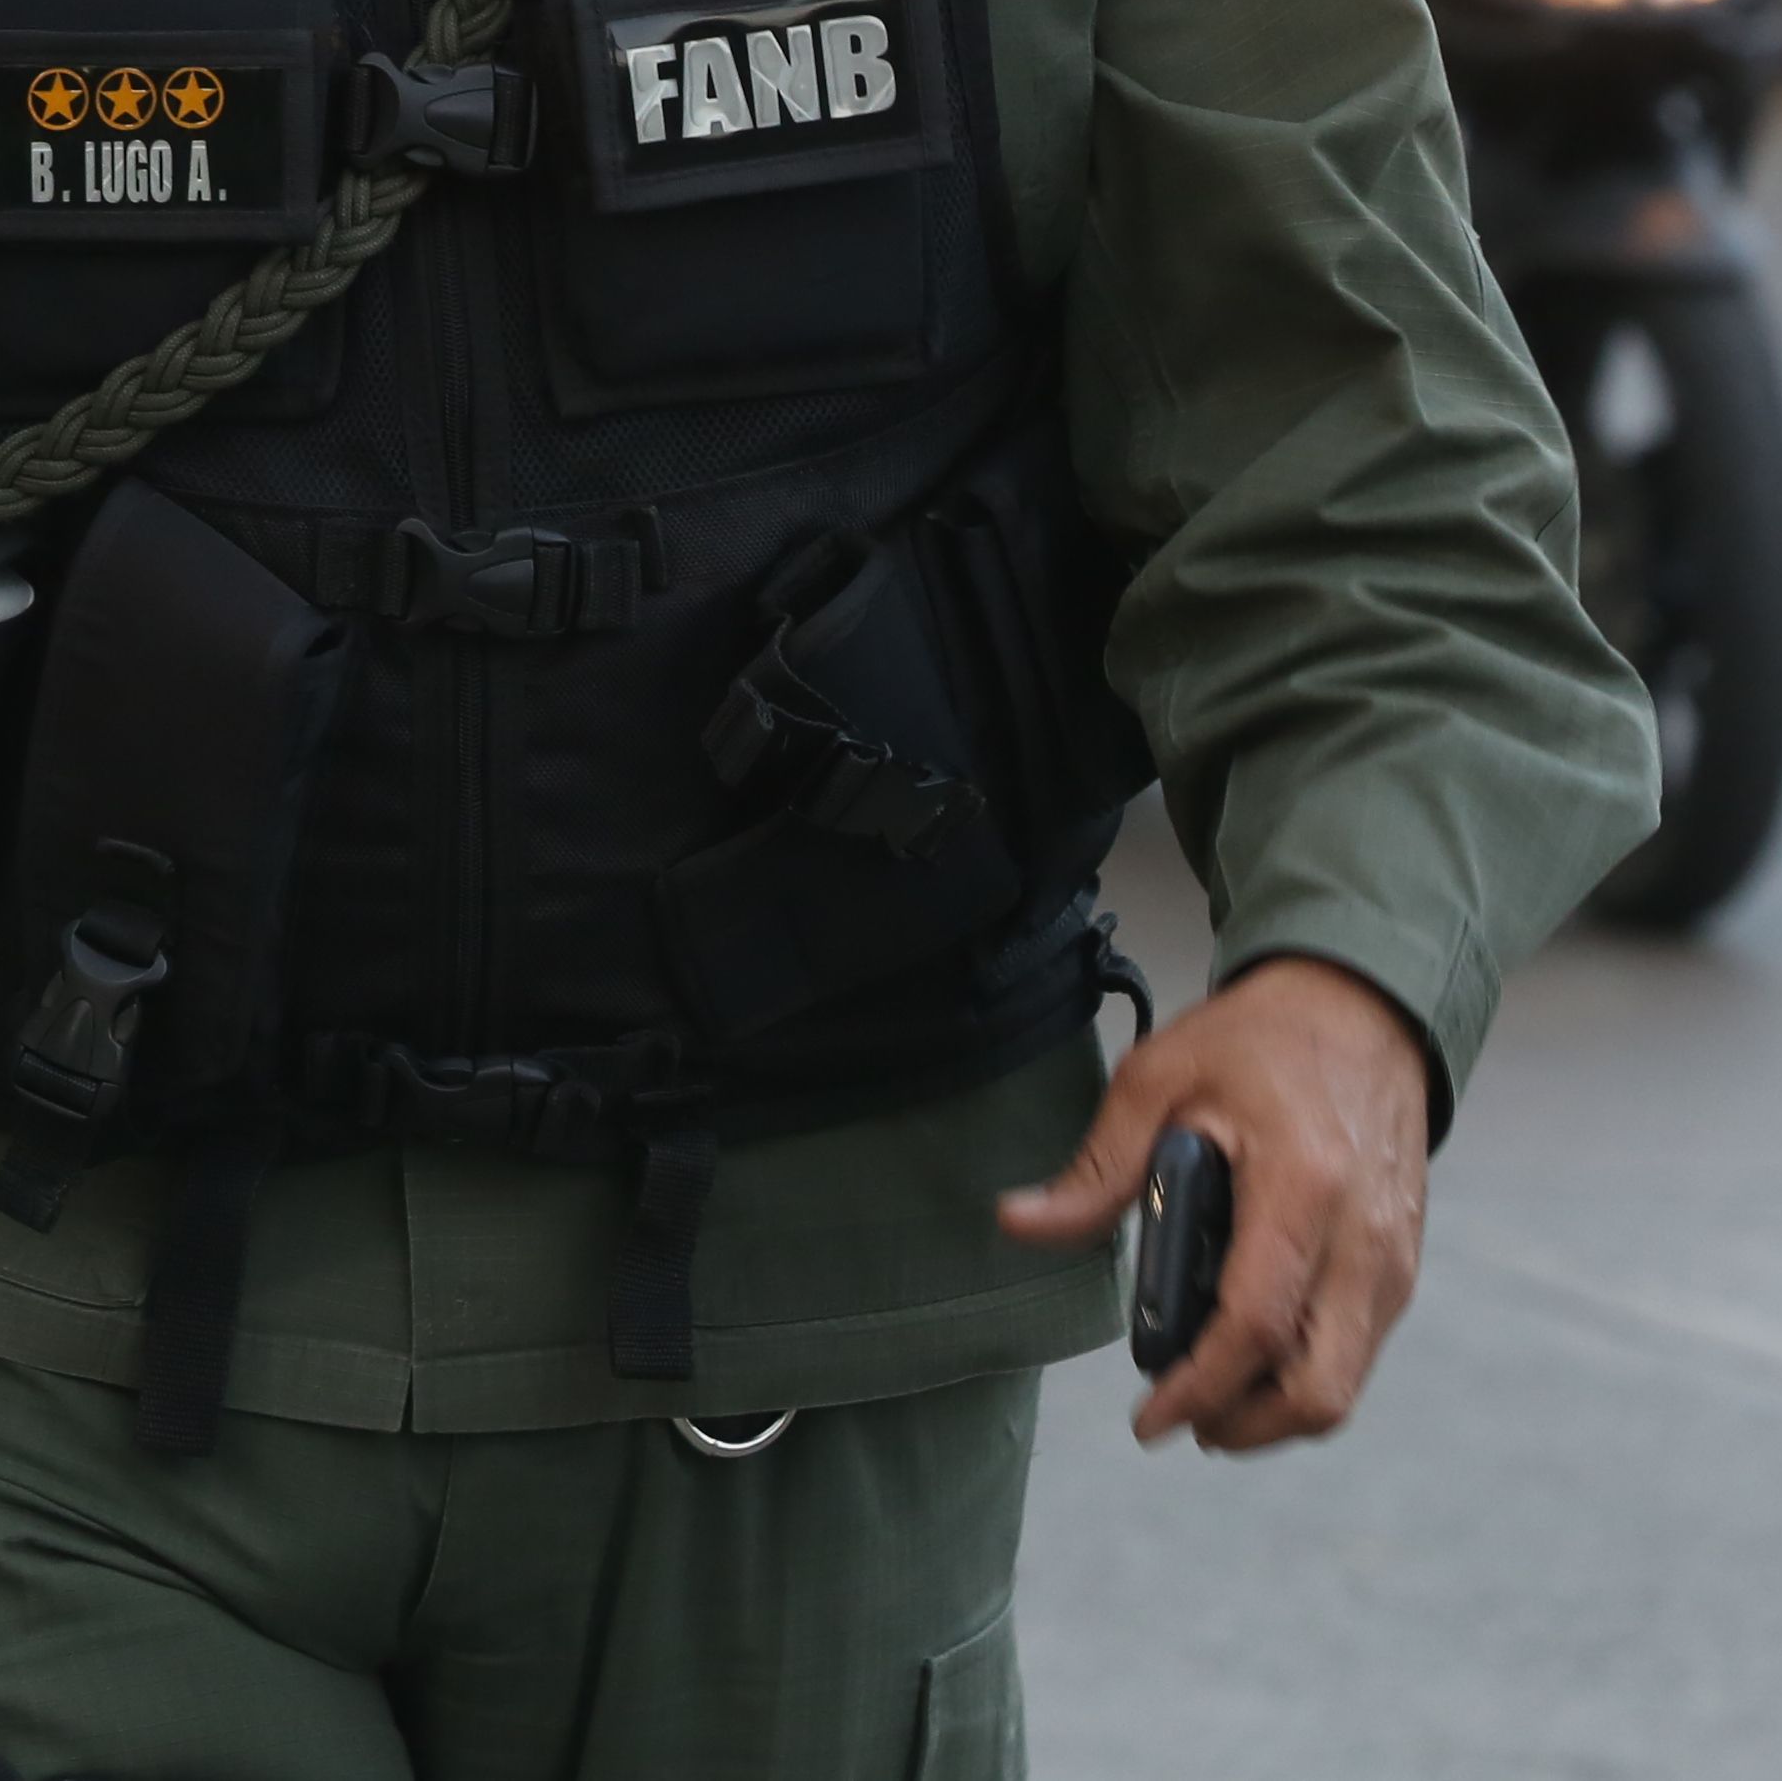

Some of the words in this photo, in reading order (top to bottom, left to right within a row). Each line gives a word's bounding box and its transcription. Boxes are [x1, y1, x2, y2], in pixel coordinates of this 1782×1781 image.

[626, 15, 896, 144] FANB
[31, 141, 71, 203] B.
[85, 139, 173, 203] LUGO
[187, 139, 227, 202] A.
